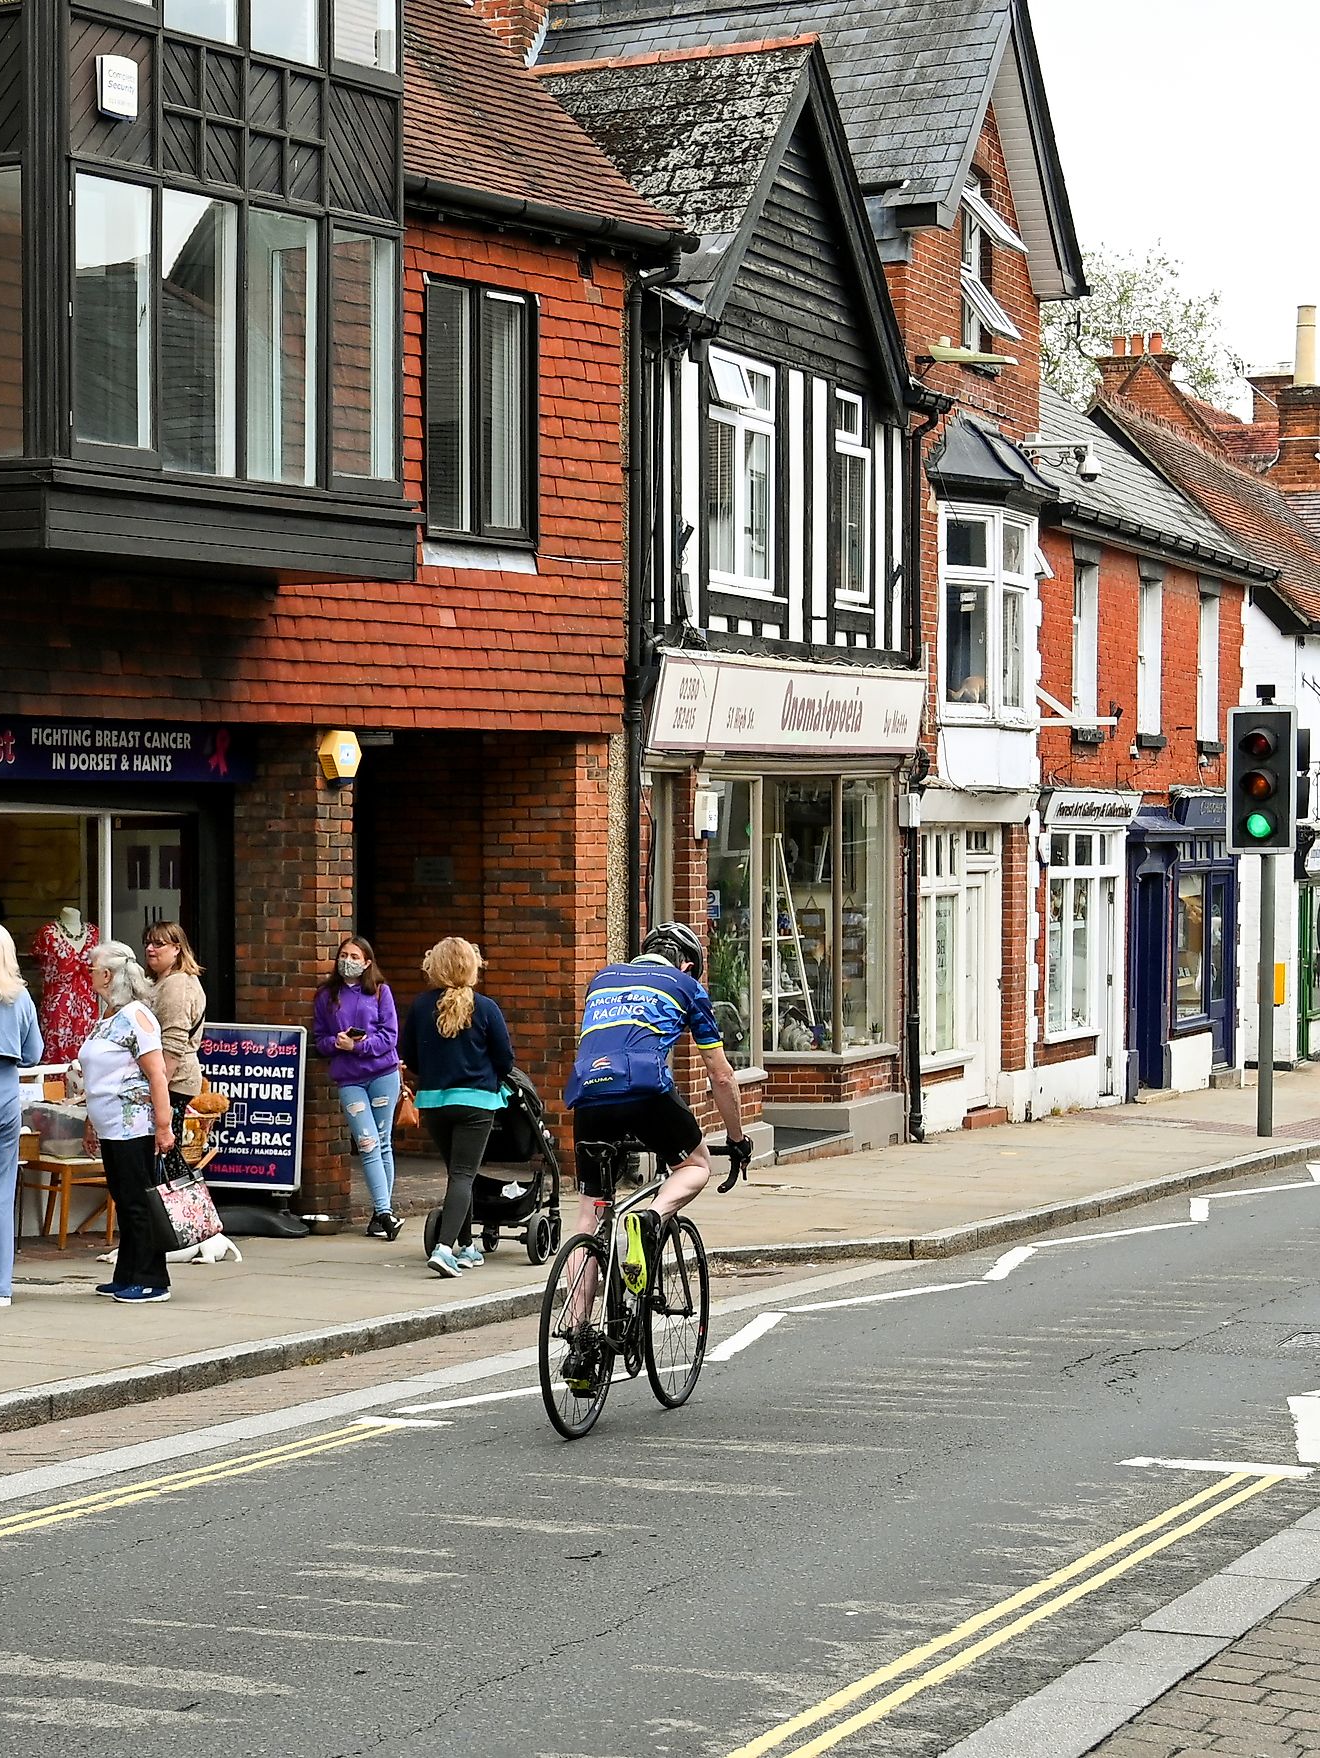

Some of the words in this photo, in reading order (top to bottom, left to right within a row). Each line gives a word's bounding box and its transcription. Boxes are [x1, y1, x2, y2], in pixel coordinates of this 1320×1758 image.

[108, 80, 135, 95] Security
[780, 679, 863, 739] Onomatopoeia
[31, 727, 91, 748] FIGHTING
[95, 729, 141, 749] BREAST
[144, 731, 192, 750] CANCER
[52, 752, 66, 770] IN
[69, 753, 117, 771] DORSET
[120, 755, 130, 771] &
[133, 755, 173, 773] HANTS
[590, 995, 623, 1008] APACHE
[626, 994, 658, 1006] BRAVE
[592, 1005, 645, 1021] RACING
[242, 1039, 265, 1056] For
[266, 1040, 297, 1058] Bust
[245, 1066, 295, 1079] DONATE
[582, 1076, 614, 1086] AKUMA
[228, 1146, 250, 1155] SHOES
[254, 1148, 292, 1157] HANDBAGS
[209, 1163, 265, 1175] THANK-YOU
